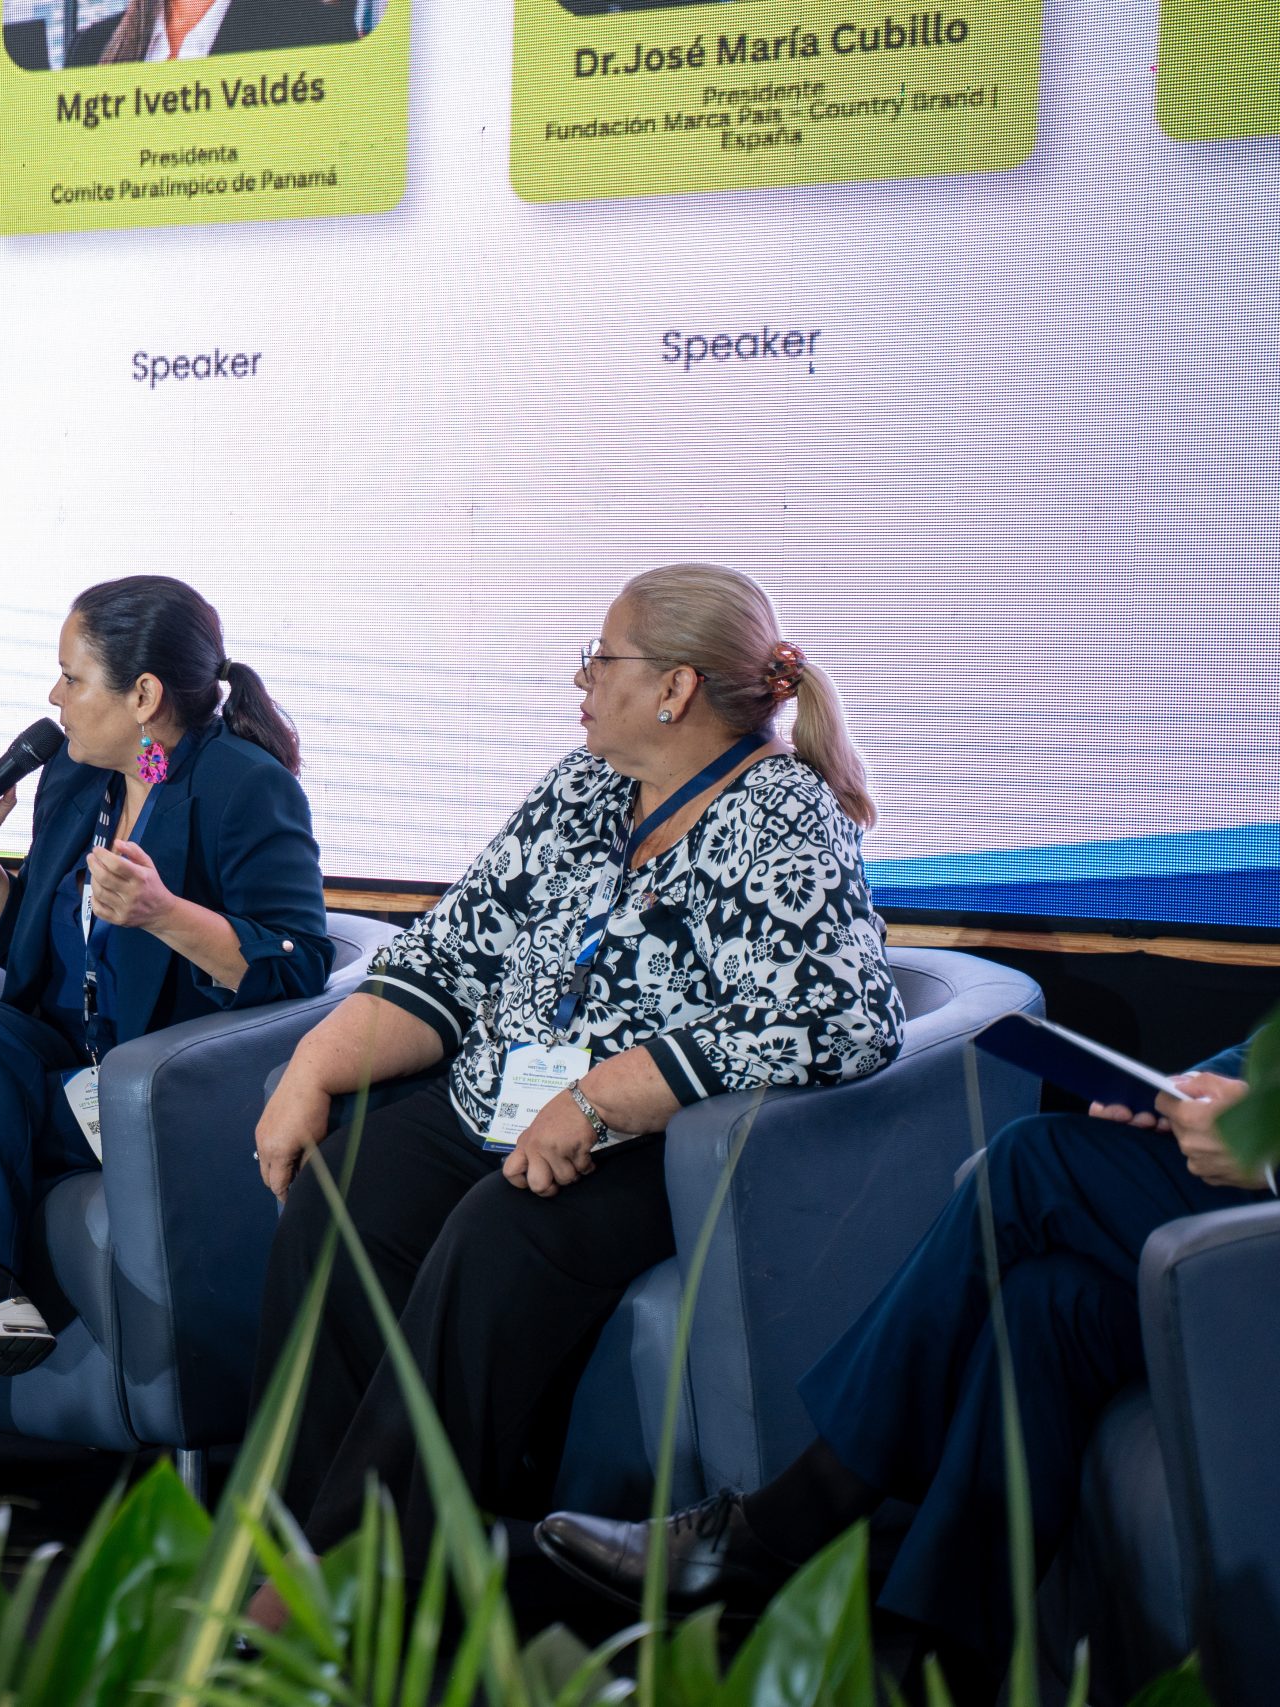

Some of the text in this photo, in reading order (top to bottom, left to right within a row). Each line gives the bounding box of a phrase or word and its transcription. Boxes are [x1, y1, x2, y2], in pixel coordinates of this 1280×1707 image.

[717, 26, 819, 66] María
[831, 13, 969, 57] Cubillo
[56, 70, 326, 129] Mgtr Iveth Valdés
[703, 80, 824, 106] Presidente
[545, 118, 657, 141] Fundación
[663, 111, 731, 132] Marca
[809, 97, 902, 122] Country
[911, 88, 984, 112] Brand
[139, 144, 239, 168] Presidenta
[721, 126, 803, 153] España
[50, 181, 115, 205] Comite
[232, 172, 256, 193] de
[261, 164, 338, 191] Panamá
[131, 347, 262, 389] Speaker
[662, 325, 820, 371] Speaker
